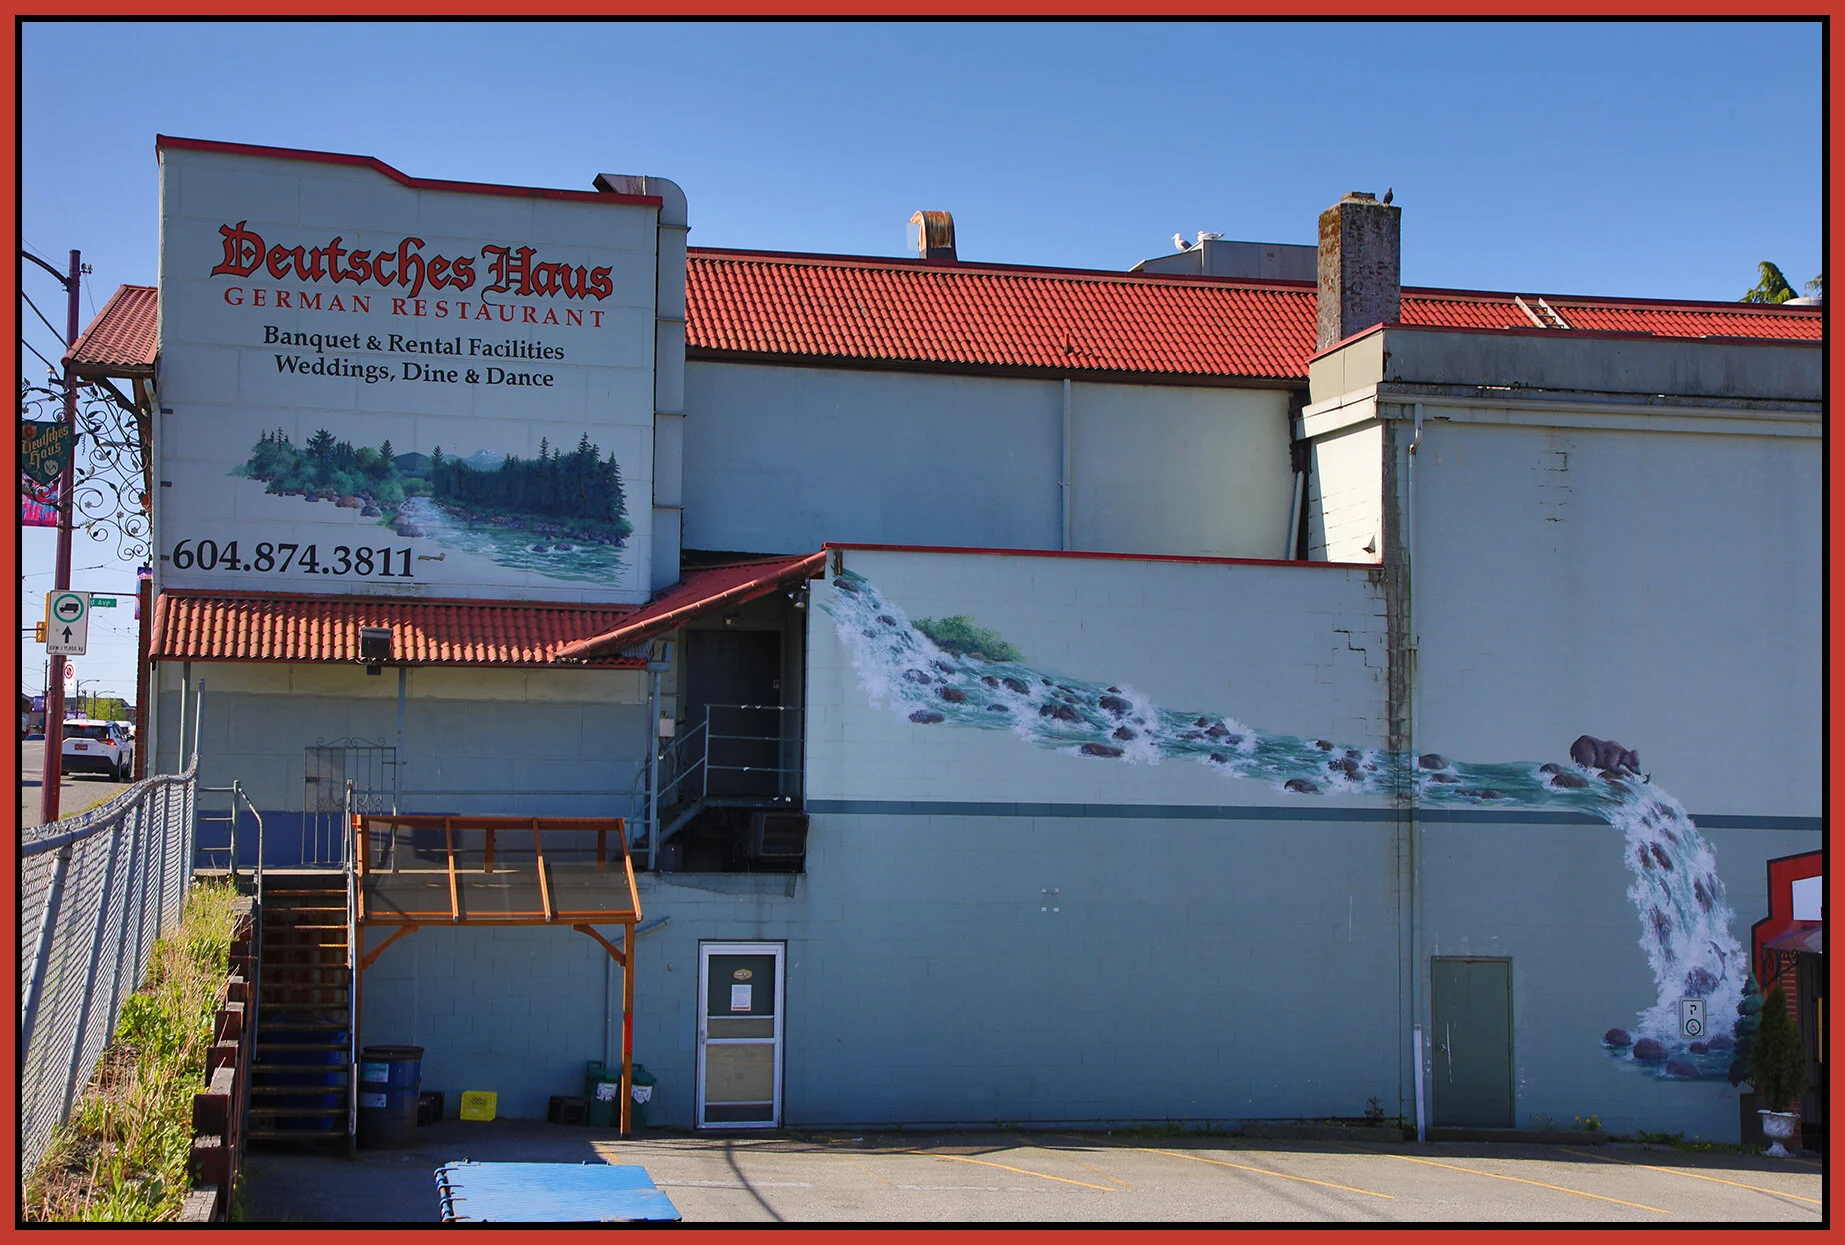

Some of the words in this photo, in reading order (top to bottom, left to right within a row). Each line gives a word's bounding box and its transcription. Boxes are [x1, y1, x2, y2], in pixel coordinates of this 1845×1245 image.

[209, 220, 476, 300] Deutsches
[480, 244, 614, 306] Haus
[223, 287, 372, 314] GERMAN
[391, 297, 606, 329] RESTAURANT
[263, 325, 362, 354] Banquet
[366, 335, 383, 352] &
[387, 333, 463, 357] Rental
[468, 337, 565, 361] Facilities
[274, 354, 396, 384] Weddings,
[402, 361, 459, 384] Dine
[464, 368, 481, 385] &
[485, 366, 555, 387] Dance
[172, 538, 414, 578] 604.874.3811
